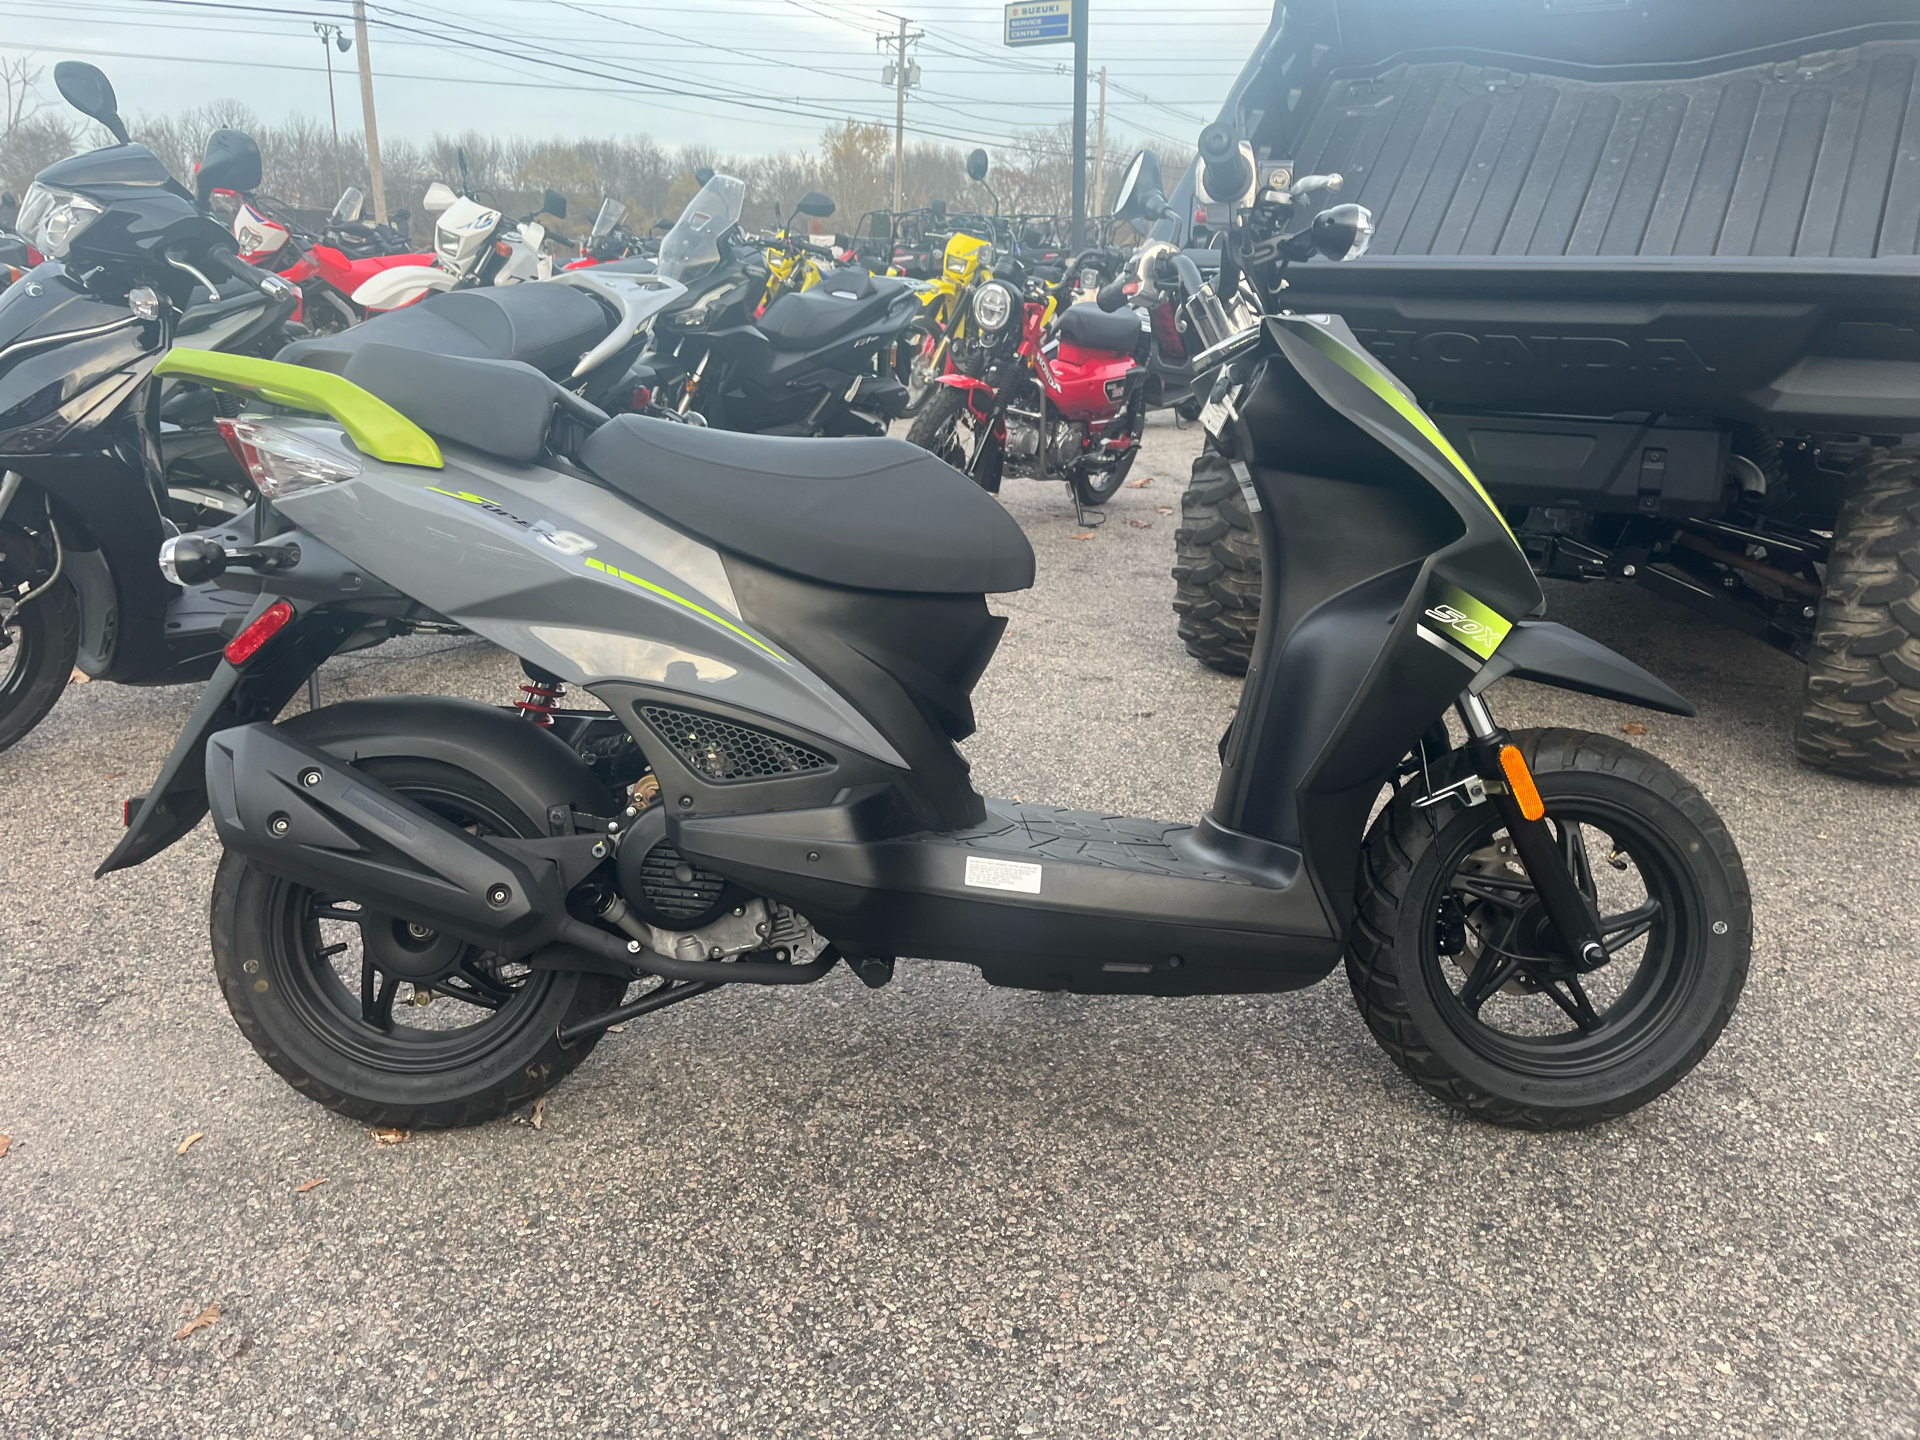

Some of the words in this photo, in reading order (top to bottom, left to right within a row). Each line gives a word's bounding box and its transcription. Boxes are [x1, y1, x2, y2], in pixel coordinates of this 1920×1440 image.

[1011, 19, 1042, 27] SERVICE
[1022, 5, 1059, 15] SUZUKI
[1011, 29, 1040, 38] CENTER
[1350, 327, 1716, 373] HONDA
[1036, 352, 1062, 394] HONDA
[1425, 604, 1503, 648] 50X
[1687, 951, 1726, 1025] KENDA
[480, 1013, 553, 1080] KENDA
